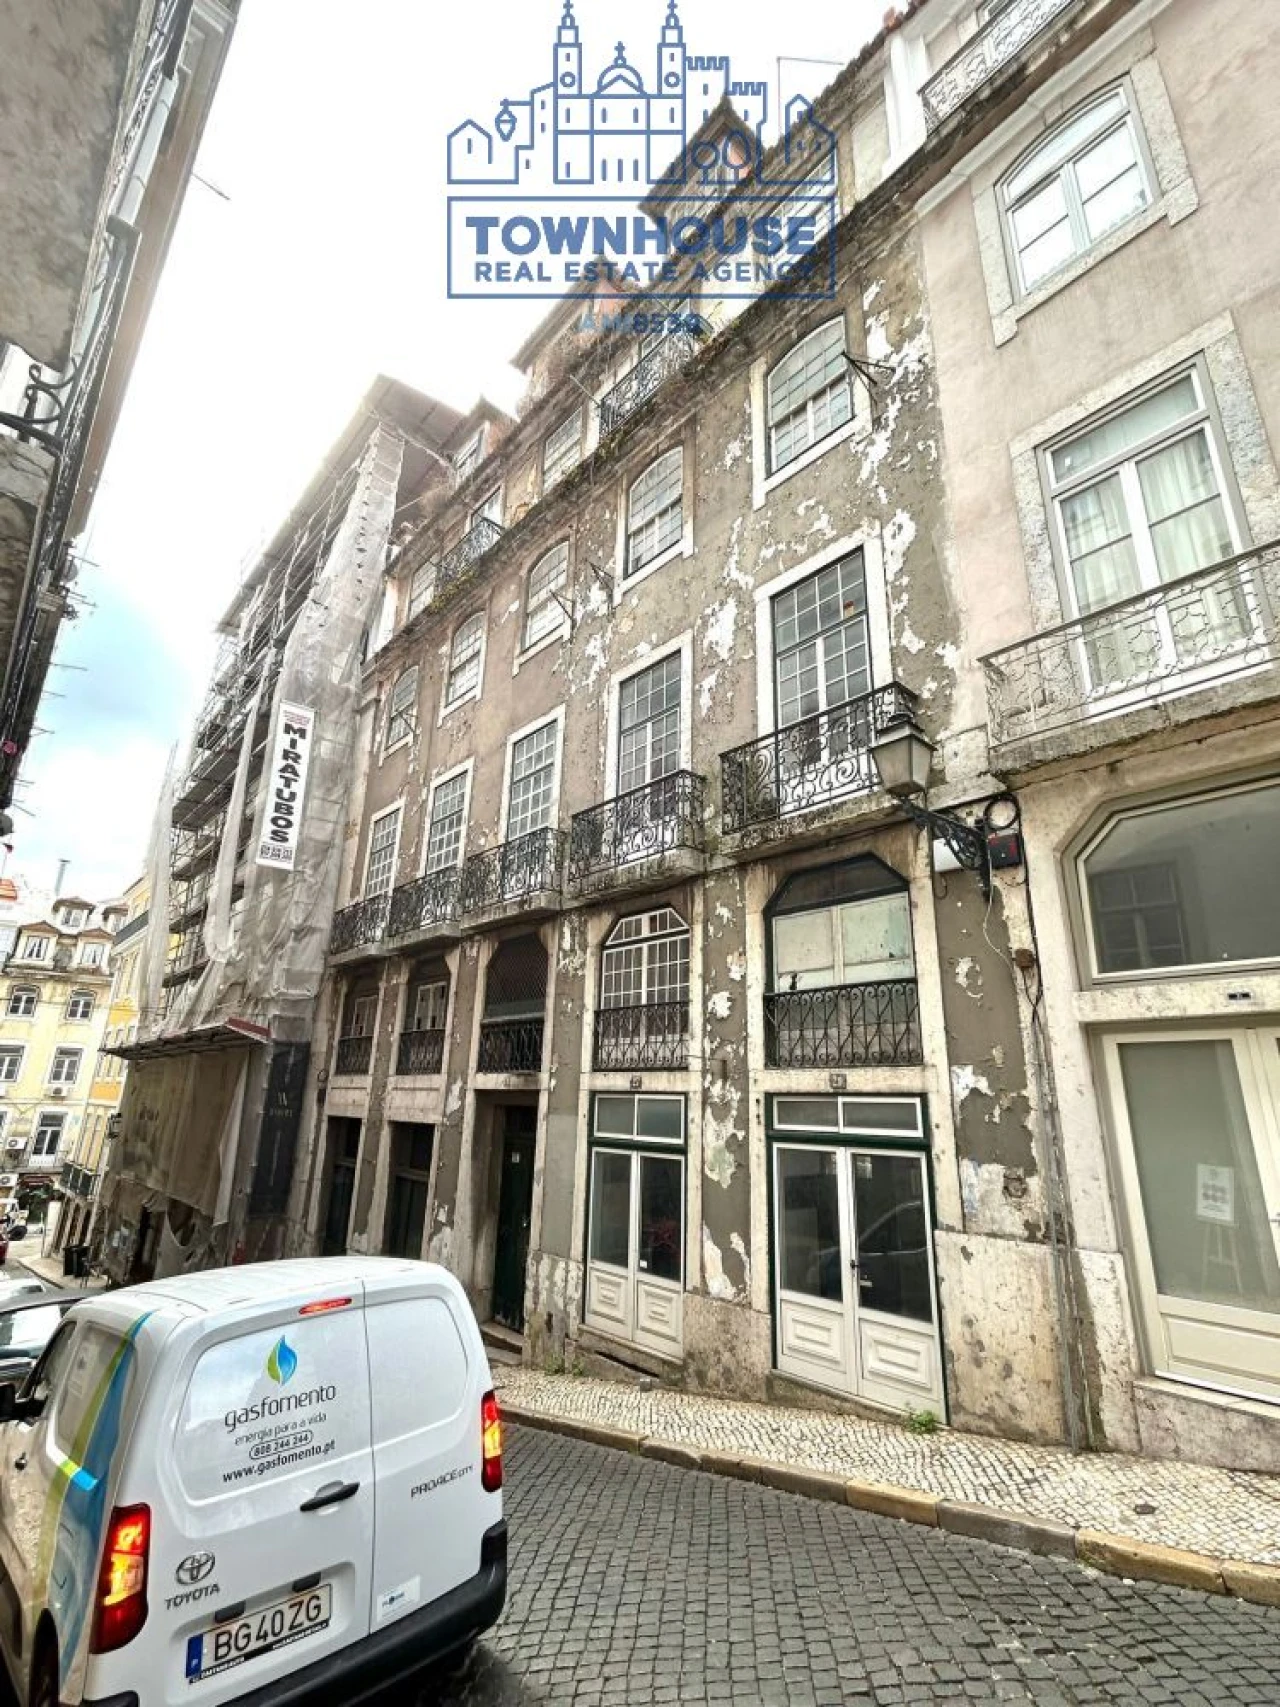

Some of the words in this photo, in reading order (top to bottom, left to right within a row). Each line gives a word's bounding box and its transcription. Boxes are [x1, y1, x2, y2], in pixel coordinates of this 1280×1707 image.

[269, 723, 307, 844] MIRATUBOS
[224, 1385, 337, 1434] gasfomento
[235, 1428, 272, 1446] energia
[274, 1422, 297, 1437] para
[308, 1412, 327, 1425] vida
[274, 1439, 291, 1452] 244
[293, 1433, 309, 1446] 244
[222, 1439, 336, 1482] www.gasfomento.pt
[164, 1583, 221, 1611] TOYOTA
